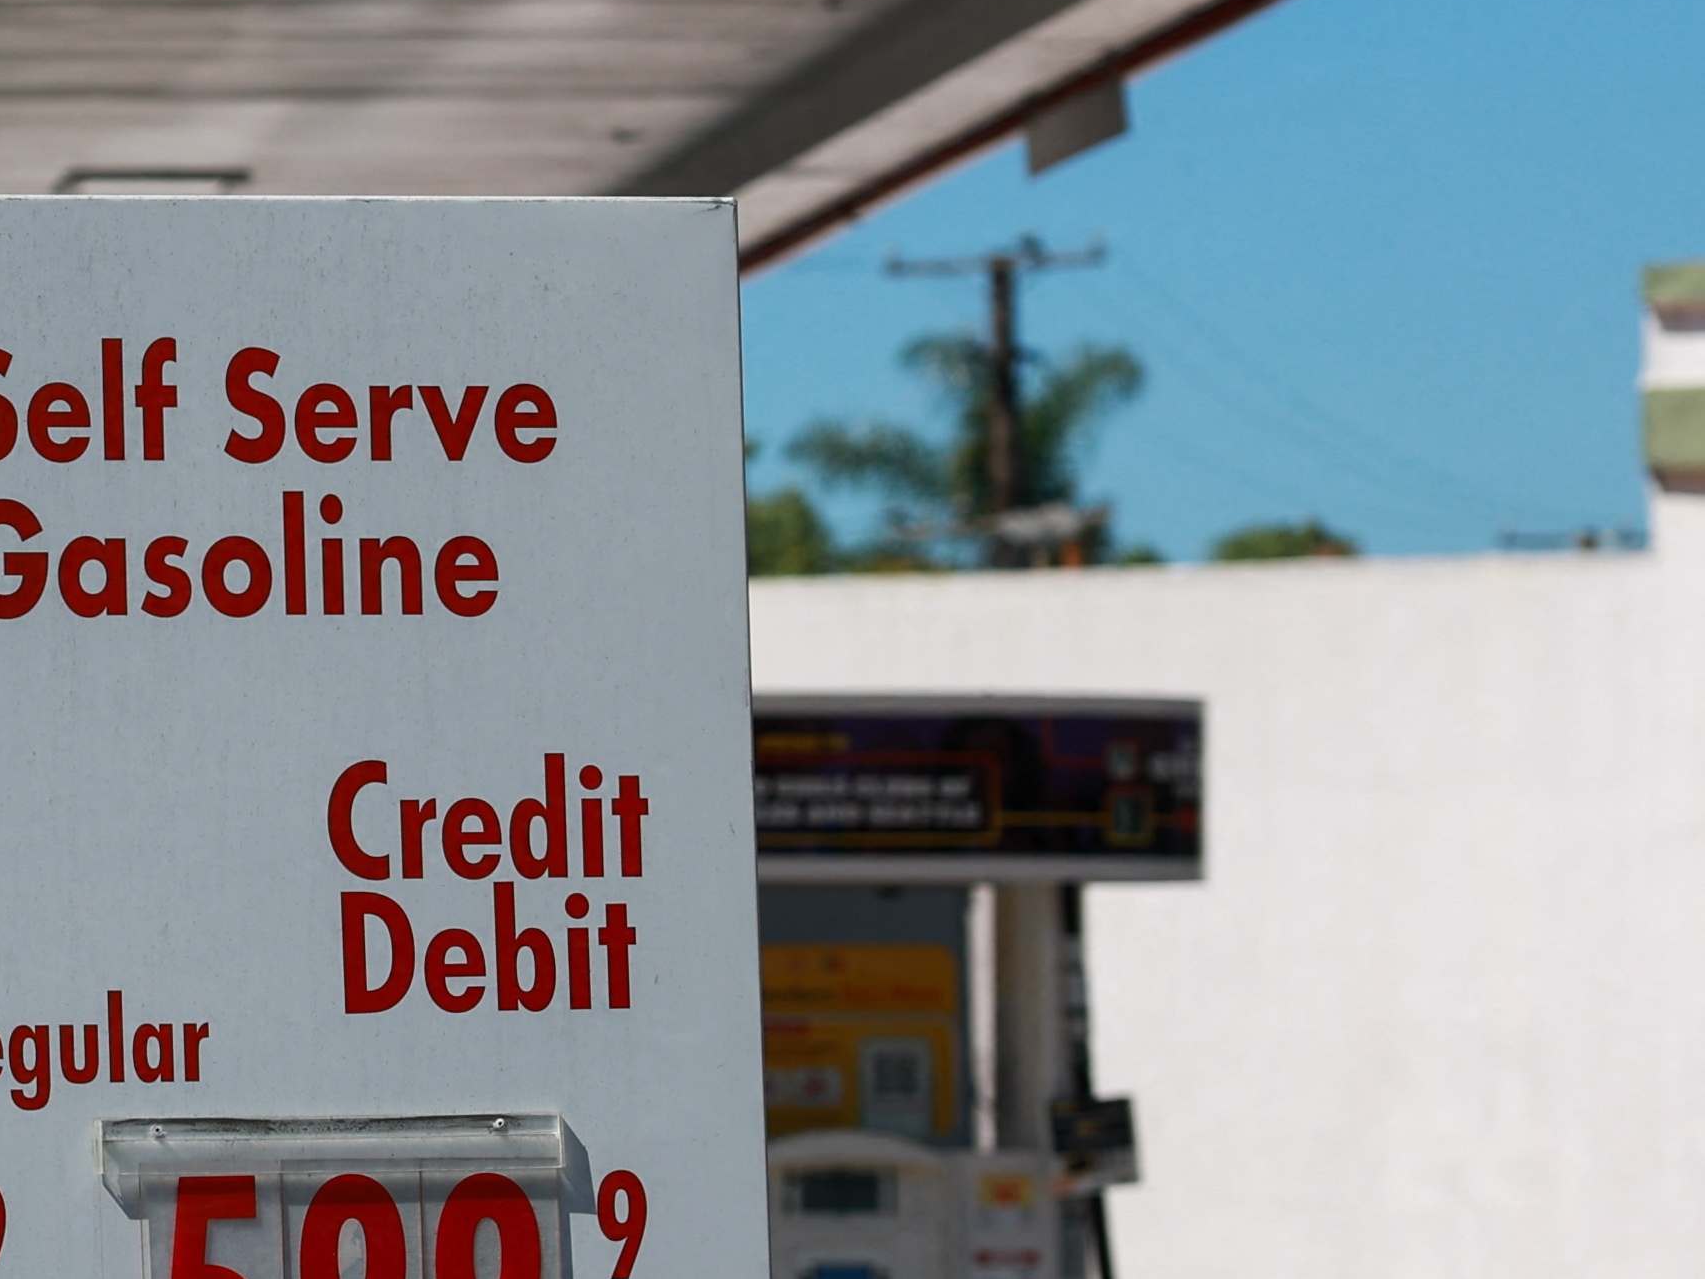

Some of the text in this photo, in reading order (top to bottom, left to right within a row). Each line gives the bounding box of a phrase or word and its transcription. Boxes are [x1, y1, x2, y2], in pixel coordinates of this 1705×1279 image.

[226, 347, 557, 463] Serve
[329, 753, 648, 880] Credit
[341, 881, 636, 1014] Debit
[597, 1170, 647, 1279] 9
